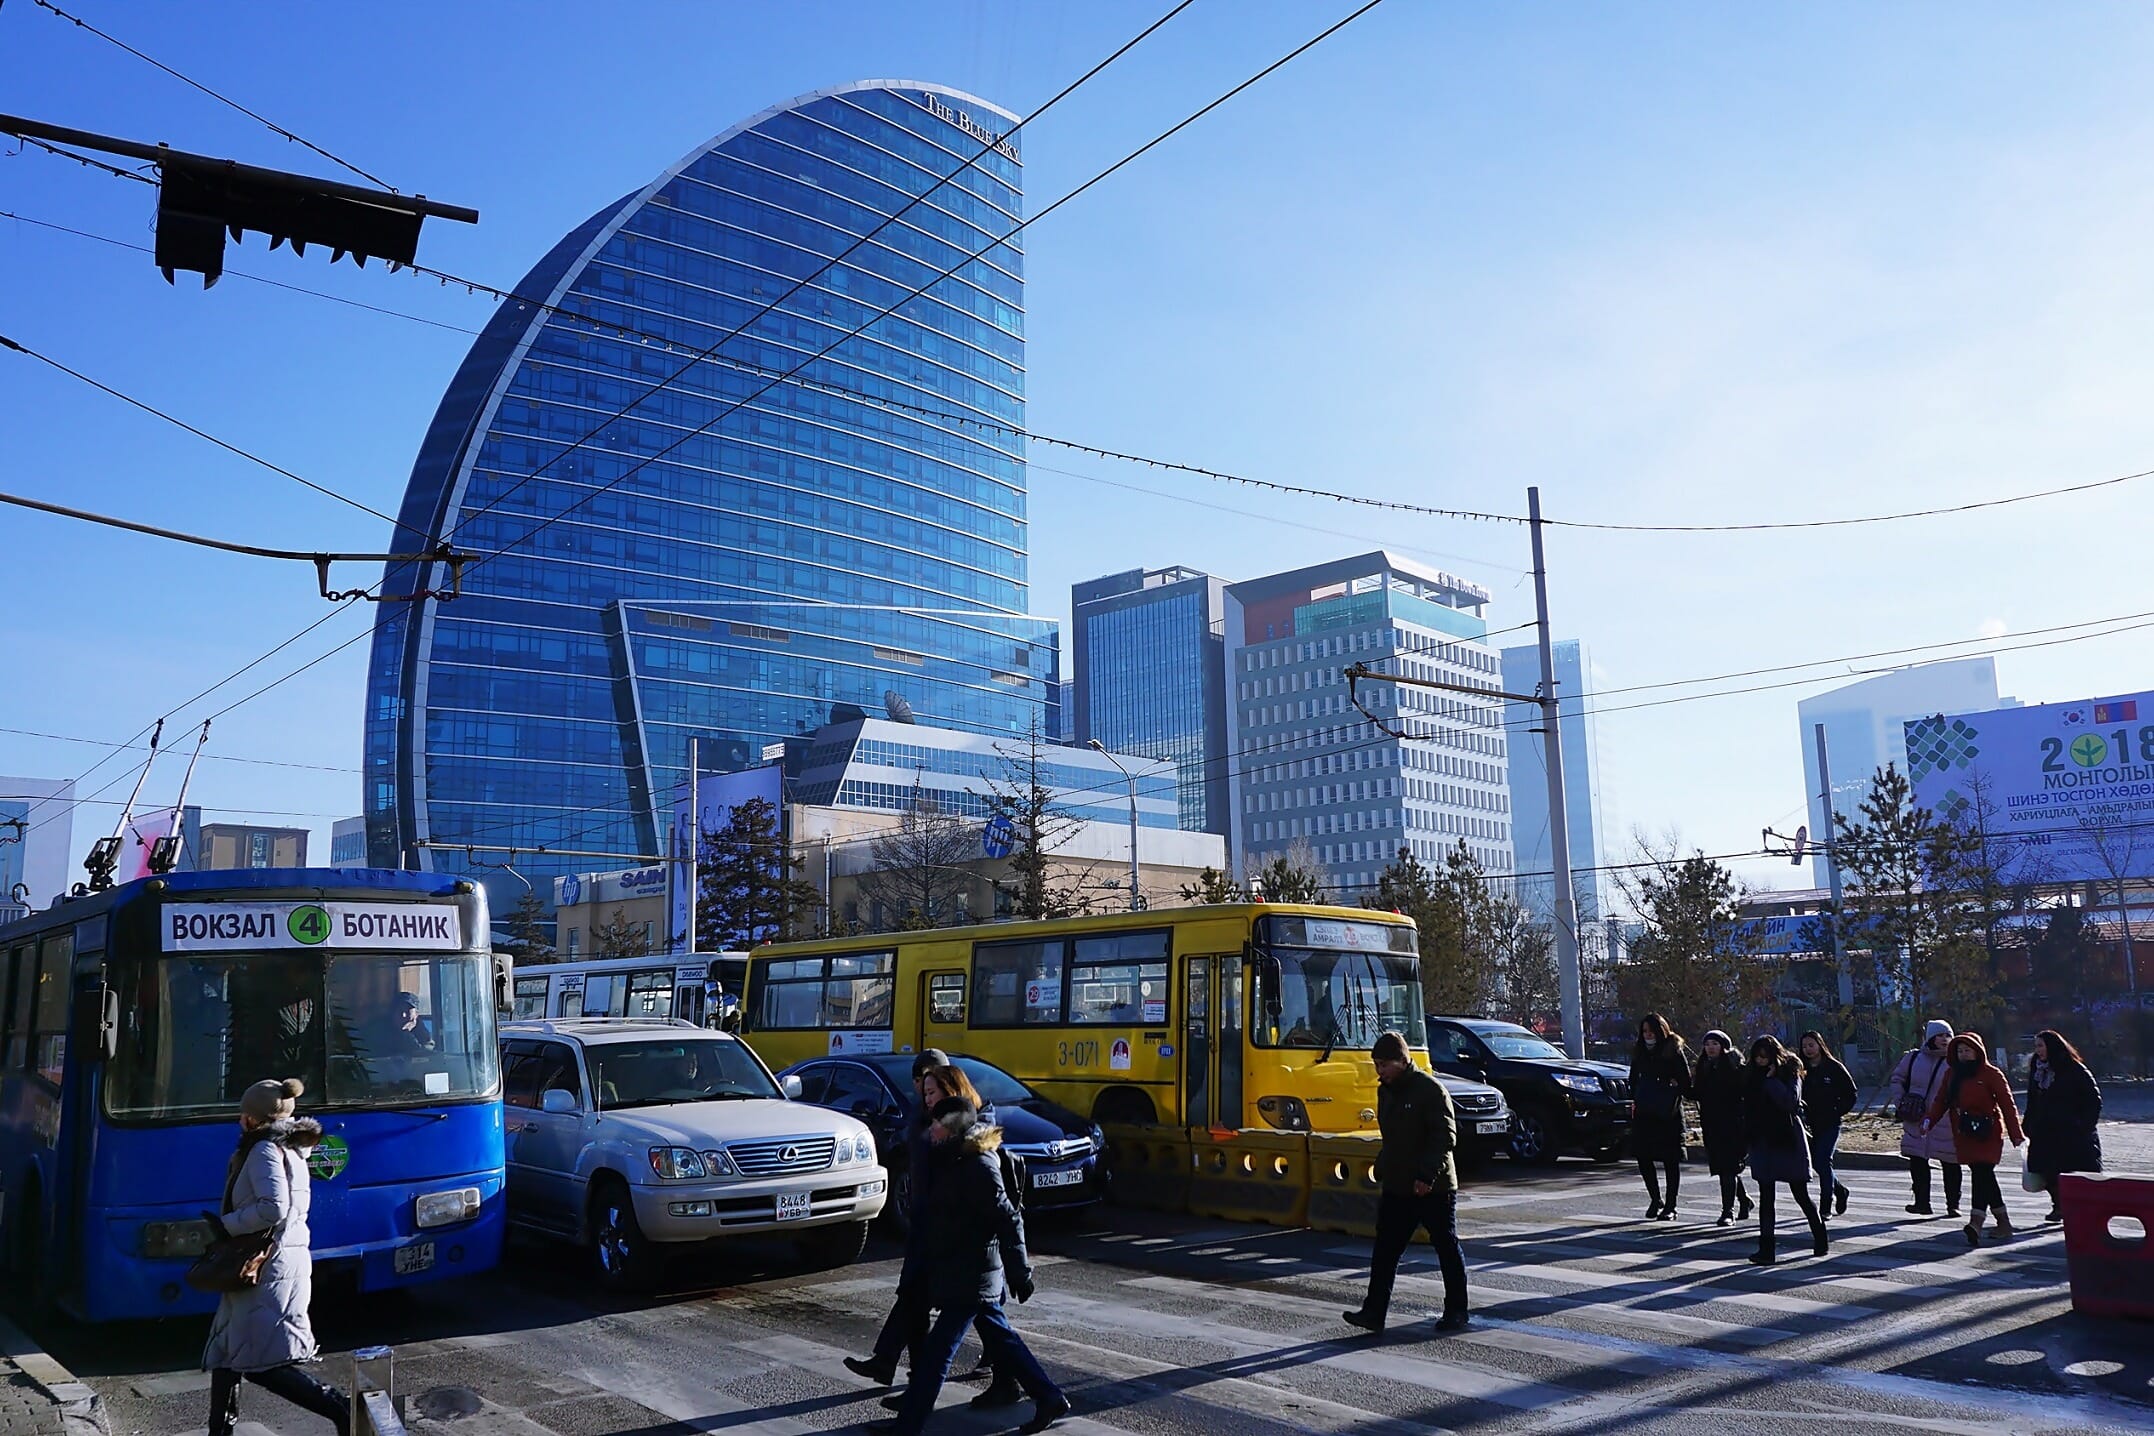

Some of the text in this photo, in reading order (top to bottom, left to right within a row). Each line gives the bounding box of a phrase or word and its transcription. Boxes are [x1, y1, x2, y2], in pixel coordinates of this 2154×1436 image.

[925, 92, 1020, 162] THE BLUE SKY
[2044, 763, 2154, 790] МОНГОЛЫ
[2007, 783, 2154, 807] ШИНЭ ТОСГОН ХӨДӨ
[2010, 807, 2080, 823] ХАРИУЦЛАГА
[2088, 800, 2154, 816] АМЬДРАЛЫ
[2079, 814, 2123, 828] ФОРУМ
[172, 912, 449, 940] ВОКЗАЛ 4 БОТАНИК
[1058, 1041, 1099, 1067] 3-071
[1038, 1173, 1059, 1186] 8242
[781, 1194, 806, 1208] 8448
[784, 1208, 801, 1219] УБВ
